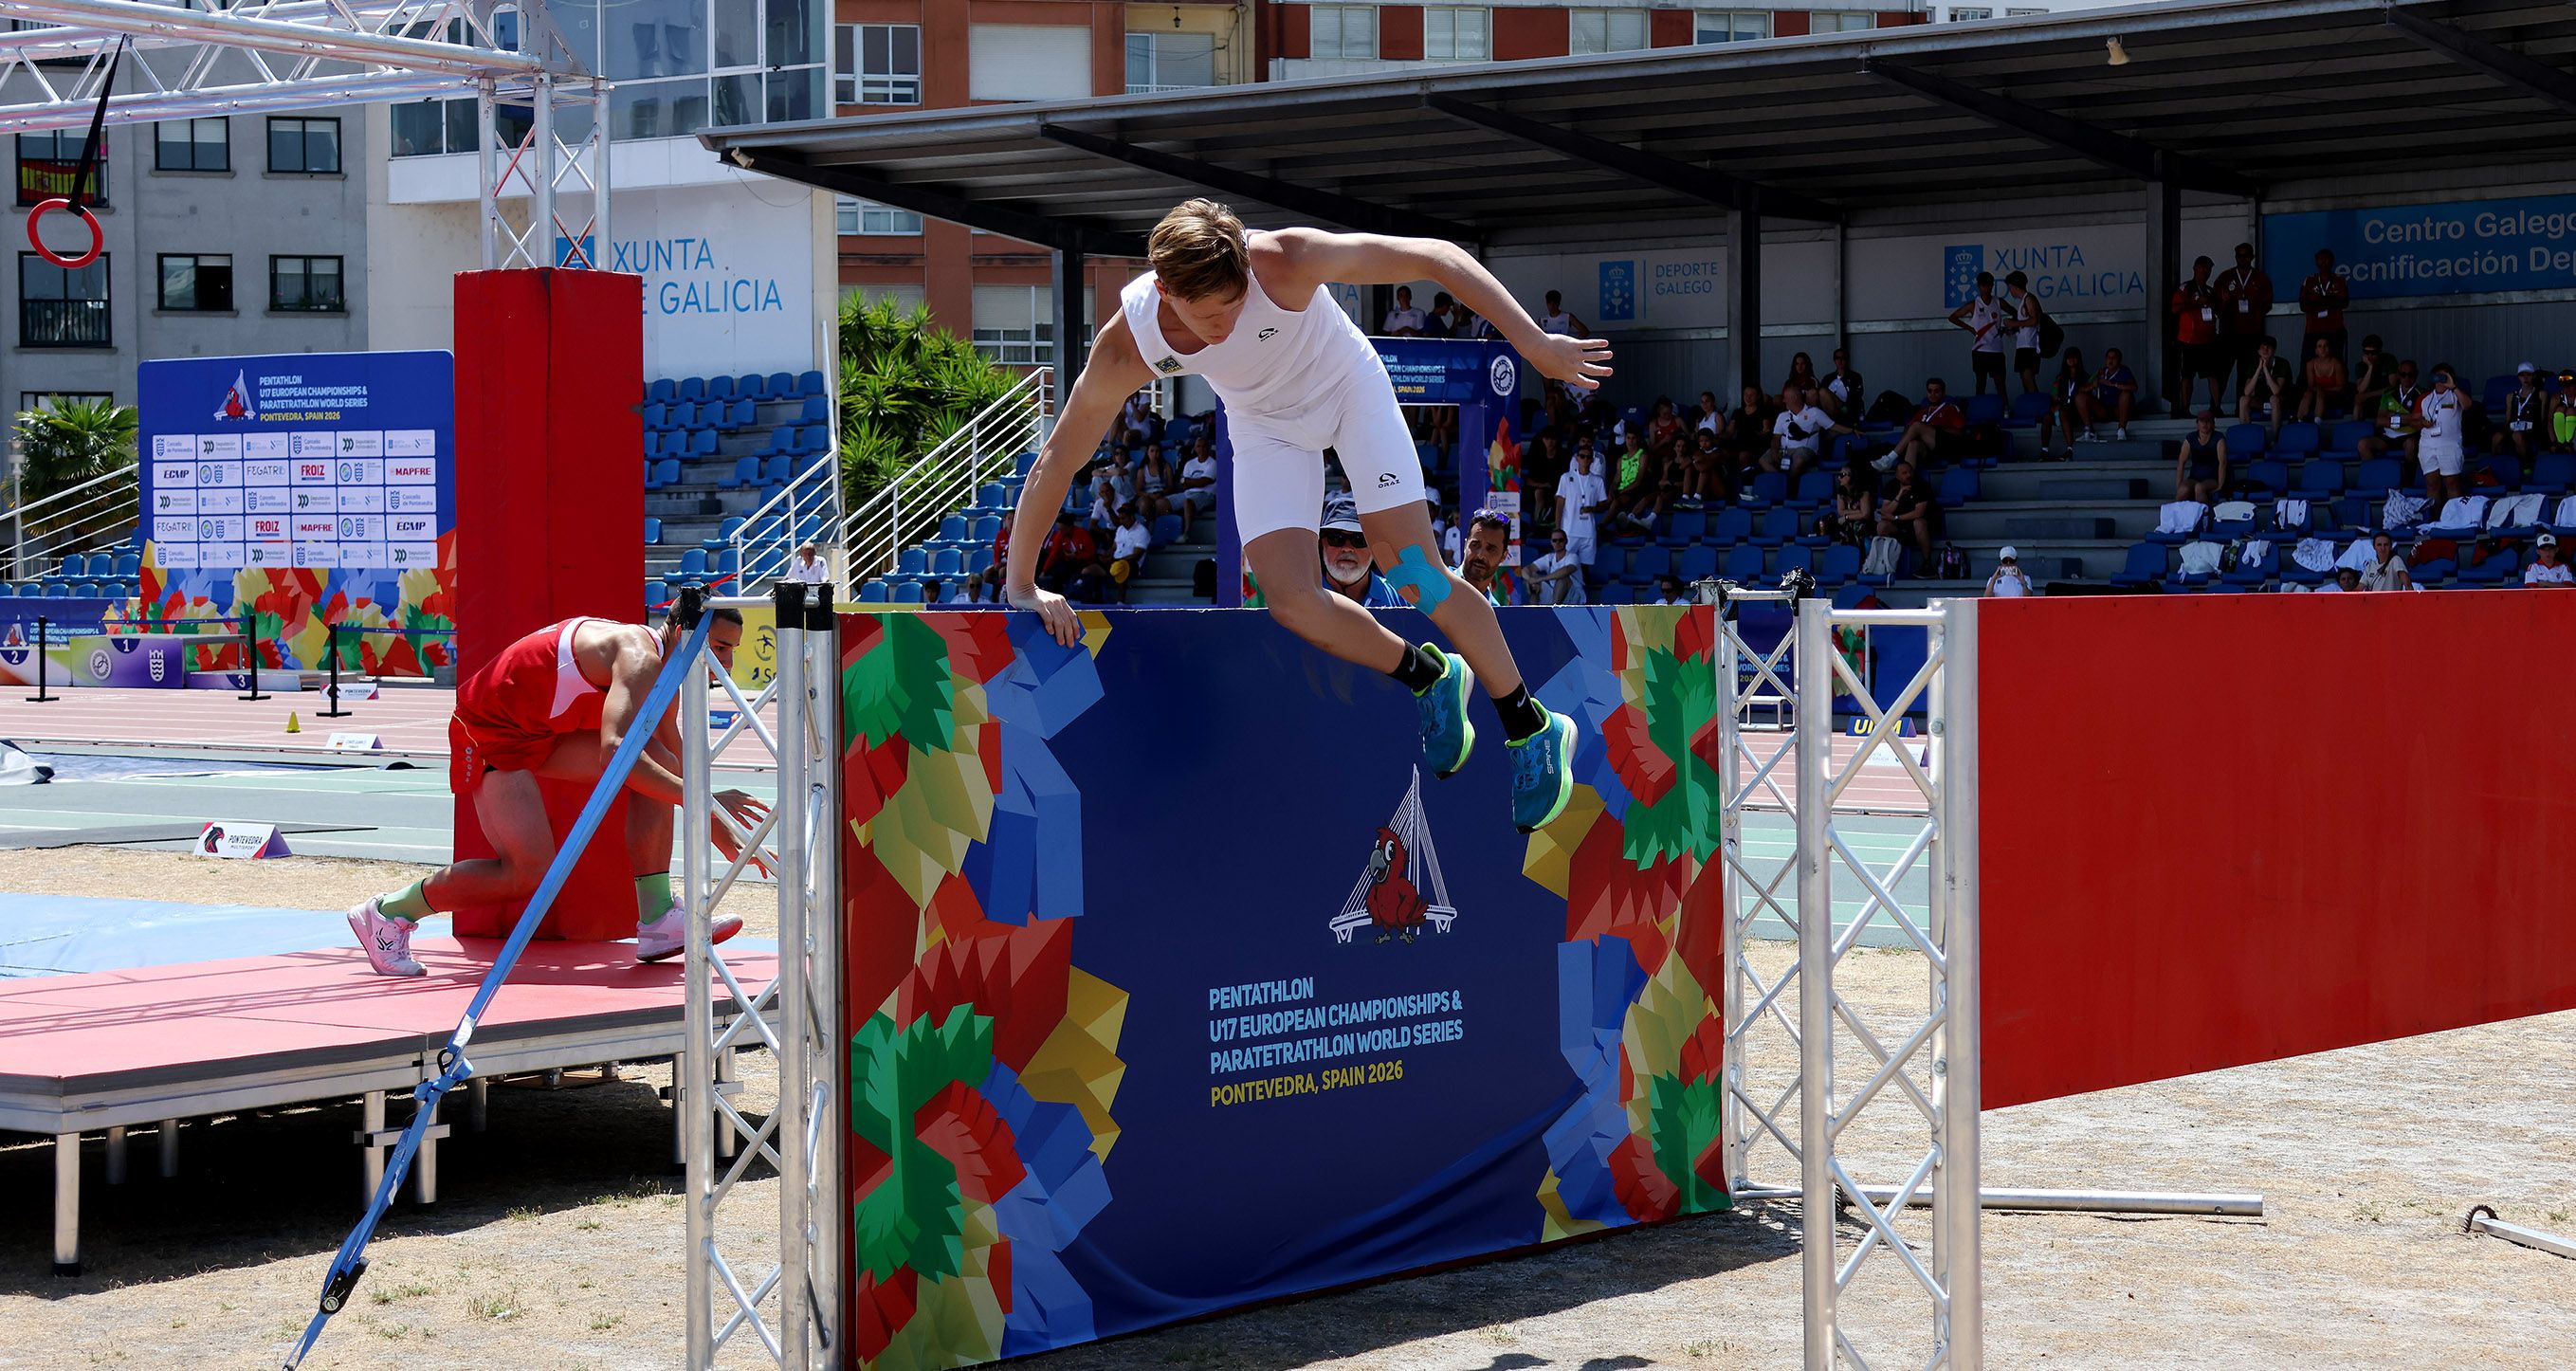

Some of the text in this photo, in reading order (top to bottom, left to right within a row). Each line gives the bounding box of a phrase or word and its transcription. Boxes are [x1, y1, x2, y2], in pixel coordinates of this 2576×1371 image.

[2364, 216, 2465, 244] Centro
[613, 238, 714, 273] XUNTA
[1995, 245, 2085, 271] XUNTA
[1655, 262, 1718, 278] DEPORTE
[2333, 247, 2576, 282] ecnificación De
[1655, 280, 1712, 296] GALEGO
[1994, 271, 2145, 299] D GALICIA
[660, 279, 783, 315] GALICIA
[260, 375, 301, 386] PENTATHLON
[260, 386, 368, 397] U17 EUROPEAN CHAMPIONSHIPS &
[260, 397, 368, 410] PARATETRATHLON WORLD SERIES
[260, 411, 340, 422] PONTEVEDRA, SPAIN 2026
[301, 465, 325, 476] FROIZ
[255, 521, 280, 532] FROIZ
[301, 523, 333, 532] MAPFRE
[123, 639, 130, 652] 1
[11, 650, 19, 663] 2
[238, 674, 246, 687] 3
[228, 834, 263, 845] PONTEVEDRA
[1209, 977, 1314, 1011] PENTATHLON
[1209, 990, 1463, 1042] U17 EUROPEAN CHAMPIONSHIPS &
[1211, 1019, 1463, 1074] PARATETRATHLON WORLD SERIES
[1211, 1060, 1403, 1107] PONTEVEDRA, SPAIN 2026
